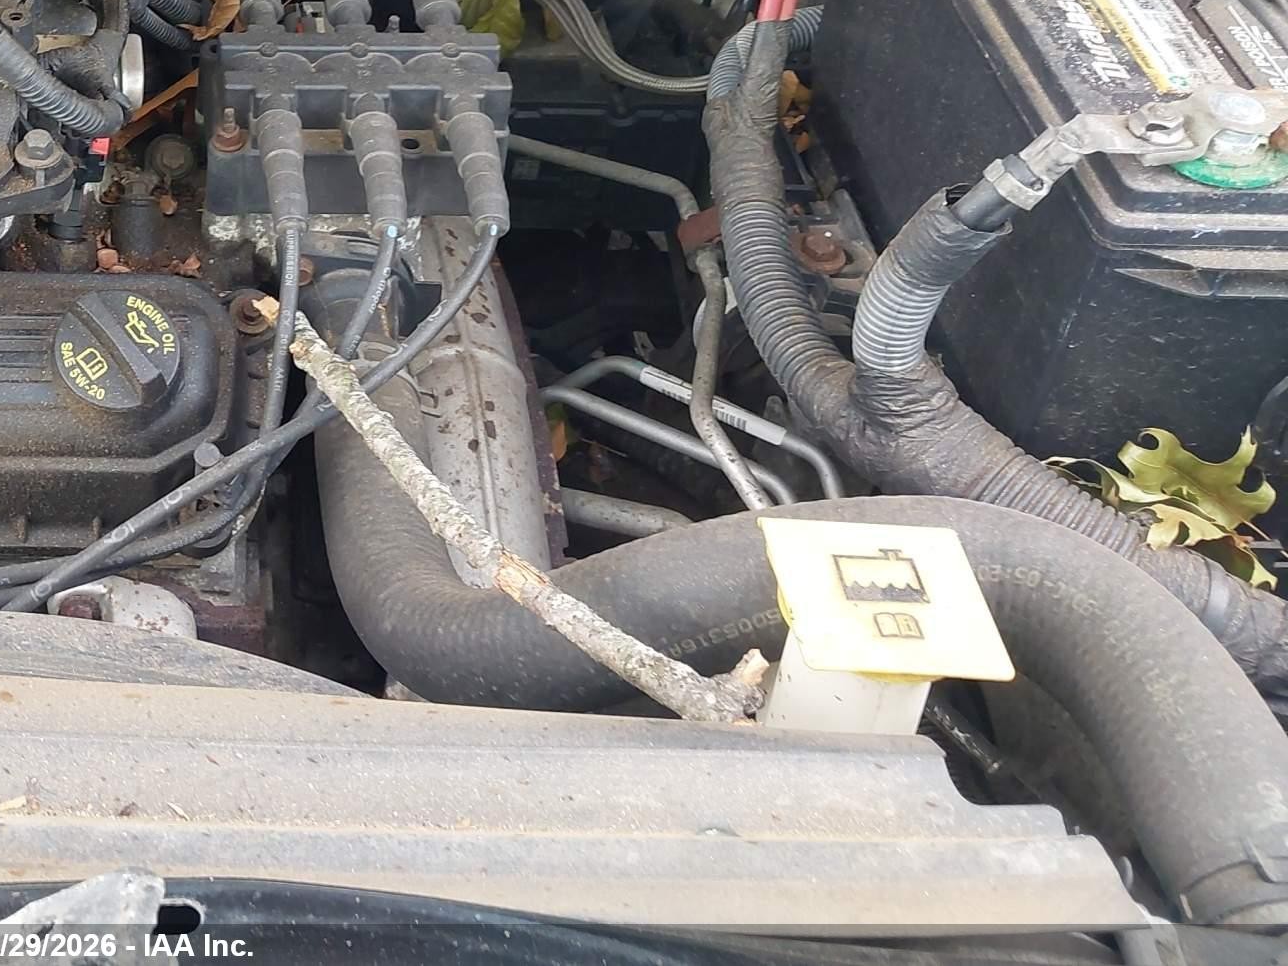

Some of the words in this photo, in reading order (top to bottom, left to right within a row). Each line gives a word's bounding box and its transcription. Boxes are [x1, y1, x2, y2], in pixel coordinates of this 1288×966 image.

[126, 296, 170, 332] ENGINE
[162, 333, 175, 355] OIL
[61, 342, 76, 367] SAE
[69, 368, 105, 400] 5W-20
